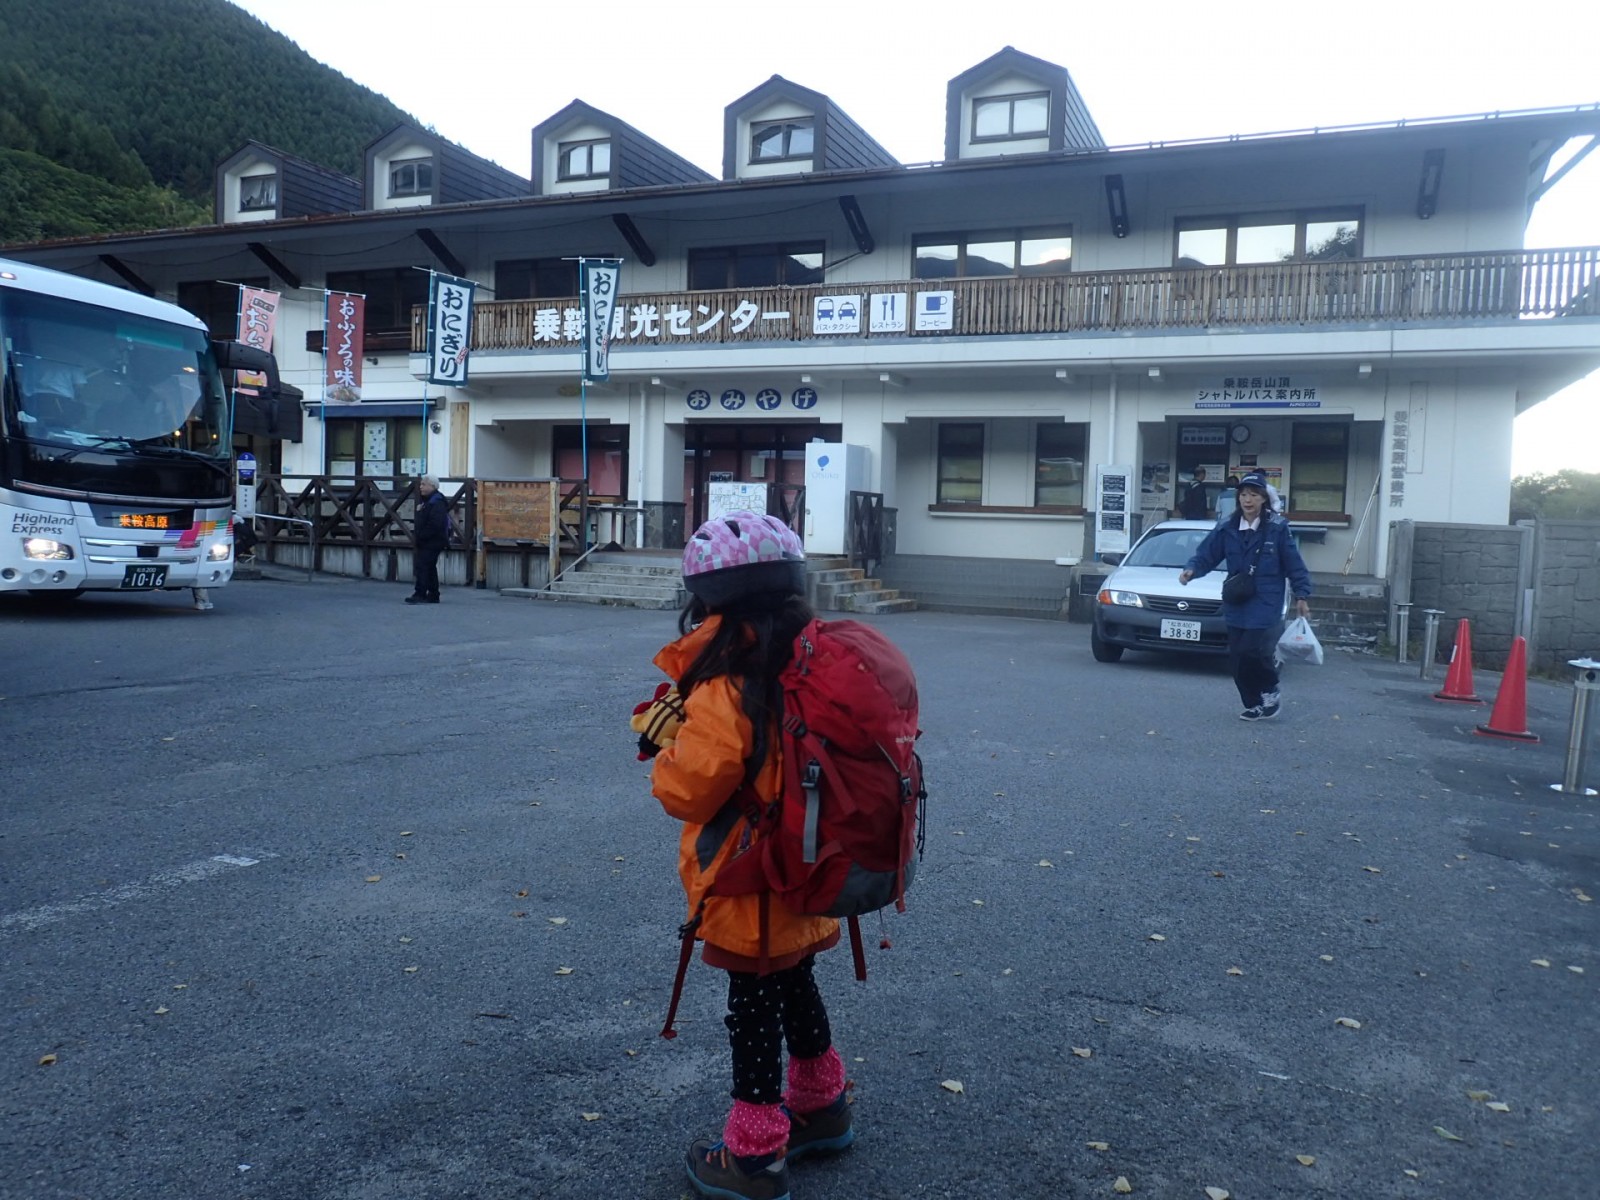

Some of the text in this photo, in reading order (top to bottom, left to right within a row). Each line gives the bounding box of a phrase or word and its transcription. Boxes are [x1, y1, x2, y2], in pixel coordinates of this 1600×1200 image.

[592, 271, 611, 370] おにぎり
[871, 321, 904, 329] レストラン
[440, 286, 463, 378] おにぎり
[334, 298, 356, 387] おふくろの味
[1223, 377, 1291, 389] 乗鞍岳山頂
[689, 388, 817, 410] おみやげ
[1198, 388, 1316, 401] シャトルバス案内所
[1390, 410, 1408, 508] 乗鞍高原営業所
[13, 512, 75, 526] Highland
[119, 514, 169, 528] 乗鞍高原
[11, 523, 63, 536] Express
[1169, 627, 1198, 639] 38-83
